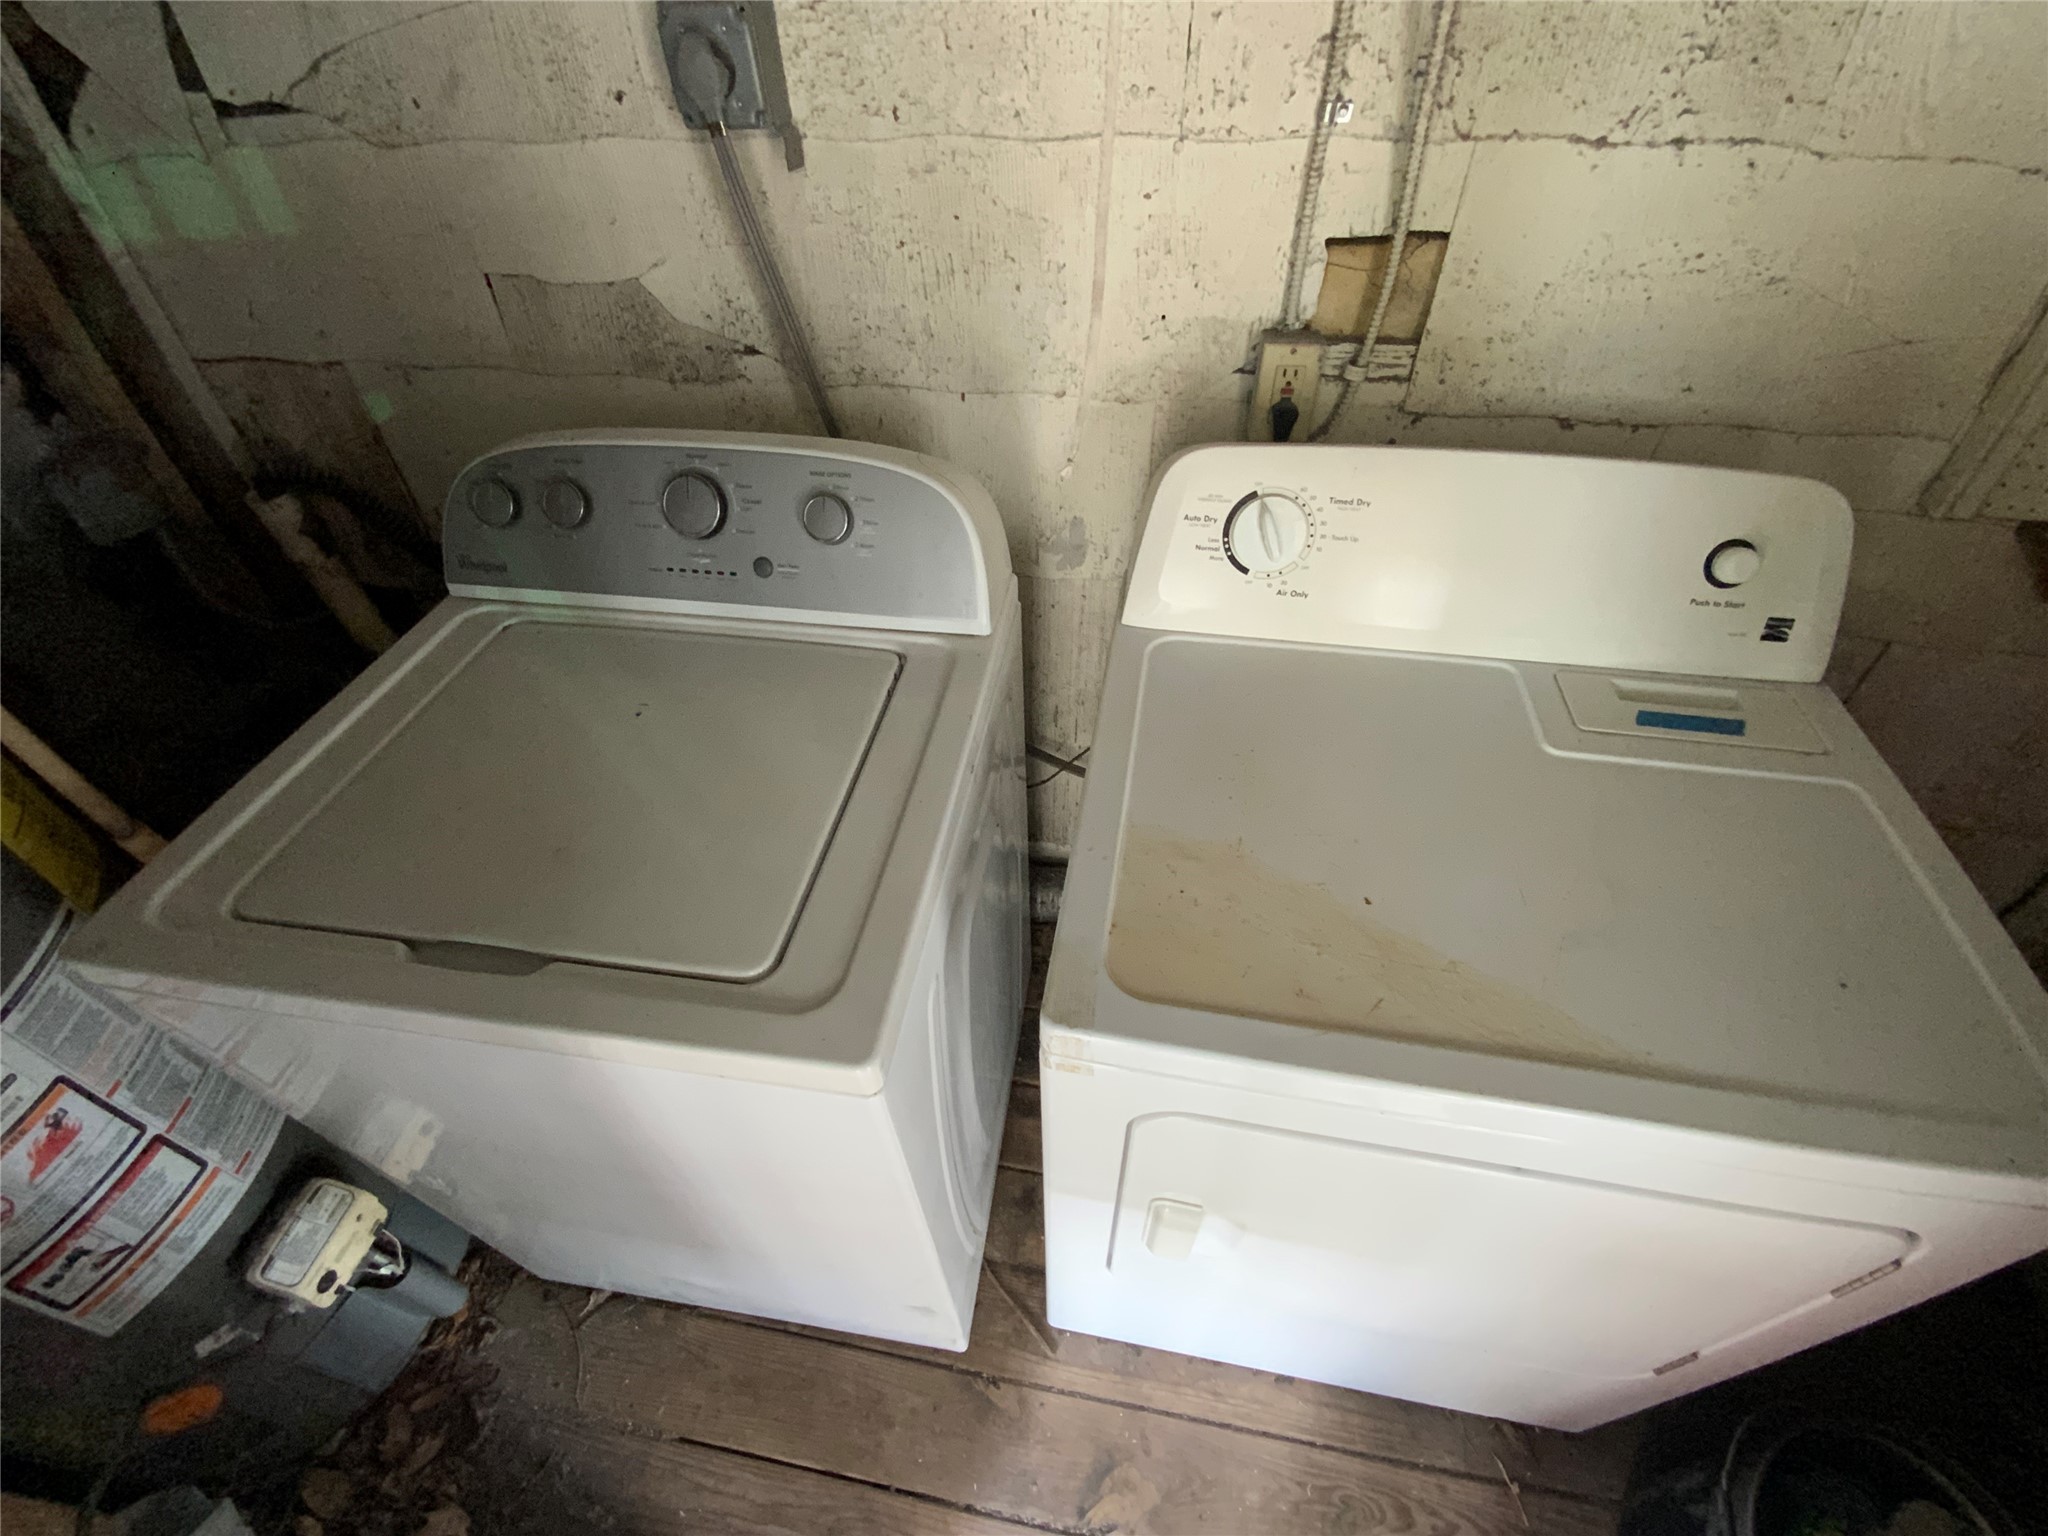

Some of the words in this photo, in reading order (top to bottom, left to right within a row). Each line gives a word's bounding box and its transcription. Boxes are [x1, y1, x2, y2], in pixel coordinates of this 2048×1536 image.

[826, 471, 852, 479] OPTIONS
[1329, 497, 1353, 507] Timed
[1356, 499, 1372, 508] Dry
[1204, 516, 1218, 524] Dry
[1331, 534, 1349, 542] Touch
[1195, 544, 1221, 552] Normal
[1276, 588, 1289, 597] Air
[1290, 590, 1309, 600] Only
[1689, 598, 1710, 607] Push
[1724, 600, 1745, 609] Start
